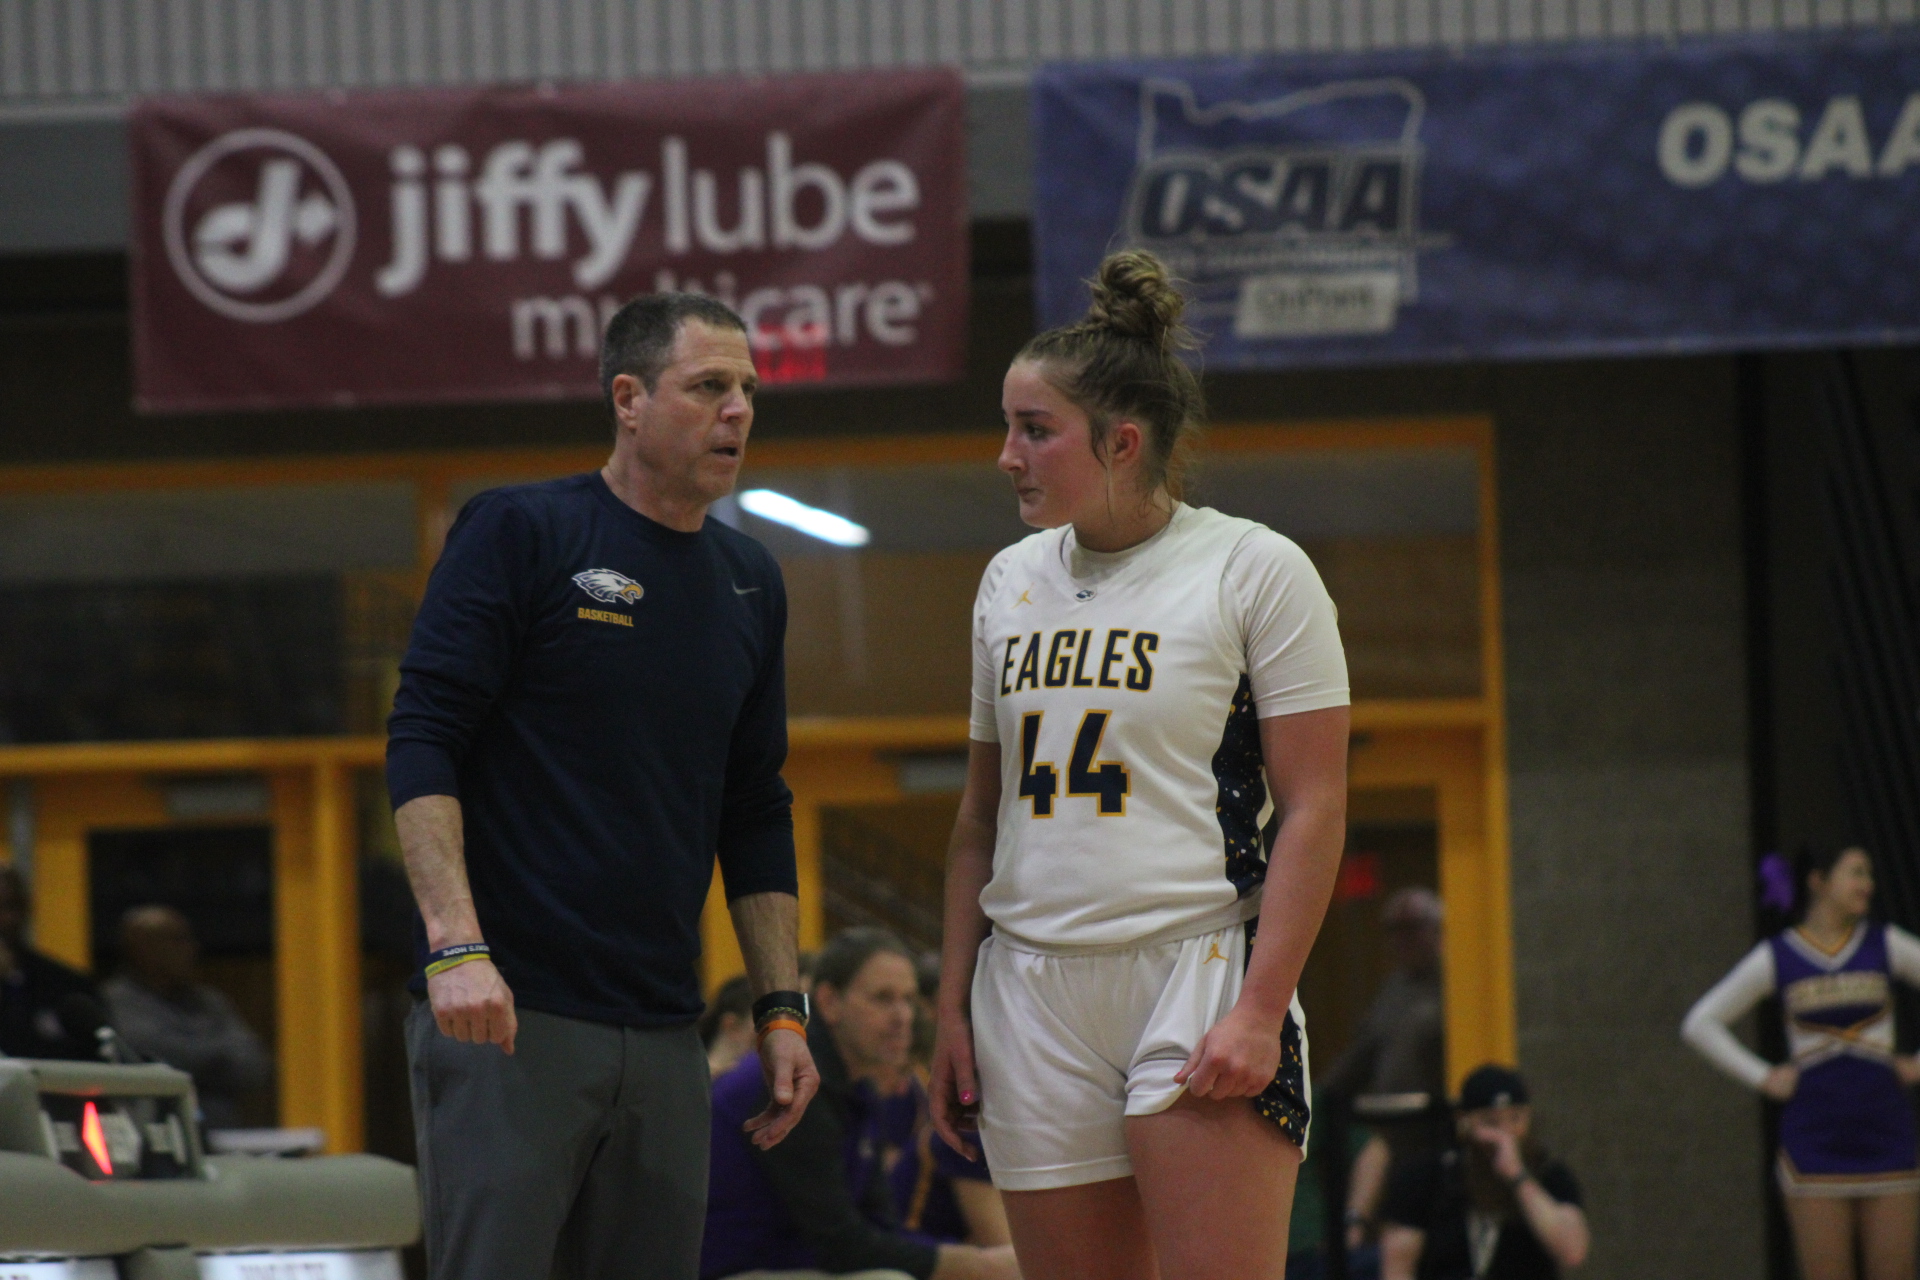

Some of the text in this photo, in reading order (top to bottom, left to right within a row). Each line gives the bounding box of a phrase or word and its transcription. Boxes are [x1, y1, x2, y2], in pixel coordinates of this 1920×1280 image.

[376, 131, 919, 295] jiffy lube
[1141, 158, 1405, 237] OSAA
[511, 270, 920, 361] mcare
[577, 607, 634, 627] BASKETBALL
[1001, 628, 1160, 697] EAGLES
[1018, 709, 1131, 819] 44
